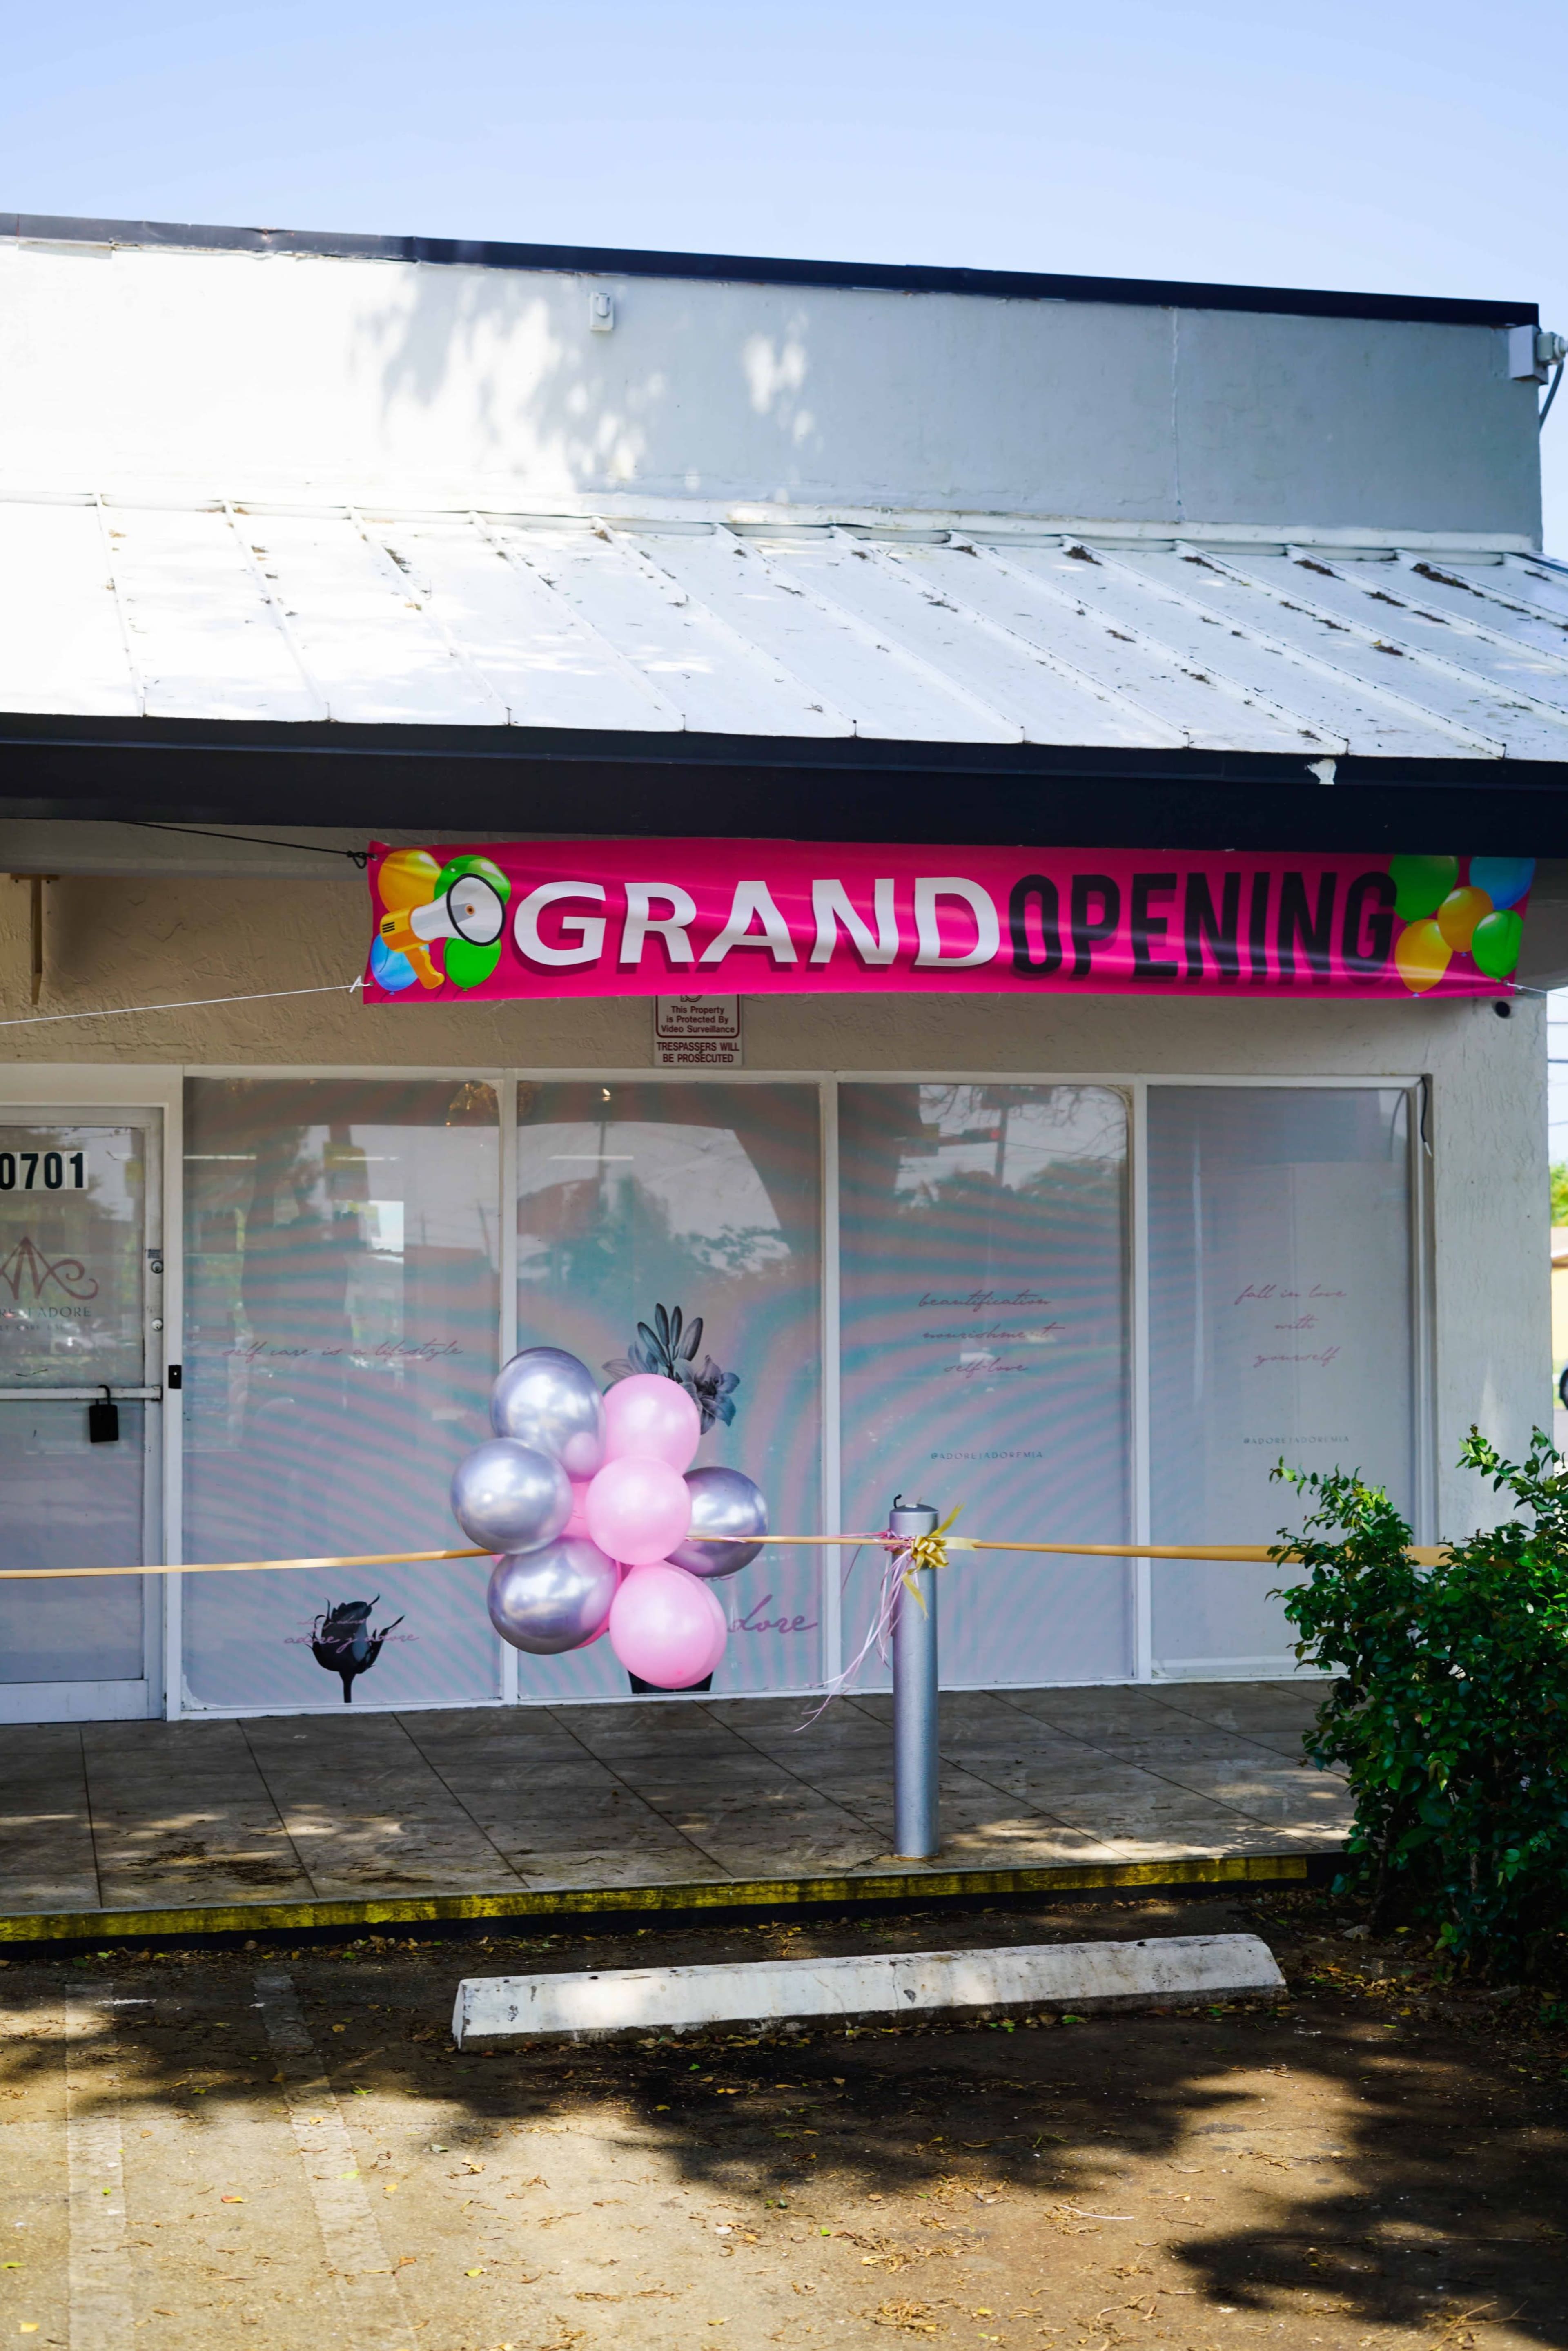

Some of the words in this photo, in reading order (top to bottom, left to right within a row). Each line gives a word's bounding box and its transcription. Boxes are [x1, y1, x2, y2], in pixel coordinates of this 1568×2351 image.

[514, 877, 1000, 967] GRAND
[1009, 871, 1397, 977] OPENING
[690, 1006, 724, 1015] Property
[719, 1016, 728, 1024] By
[657, 1042, 717, 1051] TRESPASSERS
[720, 1042, 739, 1051] WILL
[663, 1054, 674, 1062] BE
[677, 1054, 733, 1063] PROSECUTED
[0, 1152, 83, 1189] 0701
[919, 1289, 1051, 1312] beautification
[1234, 1284, 1277, 1305] fall
[1280, 1289, 1301, 1298] in
[1309, 1284, 1348, 1298] love
[922, 1322, 1065, 1339] nourishment
[1275, 1314, 1319, 1329] with
[222, 1341, 267, 1363] self
[321, 1347, 343, 1356] is
[375, 1338, 463, 1362] lifestyle
[1253, 1347, 1341, 1368] yourself
[944, 1357, 1028, 1378] self-love
[728, 1594, 818, 1633] dore
